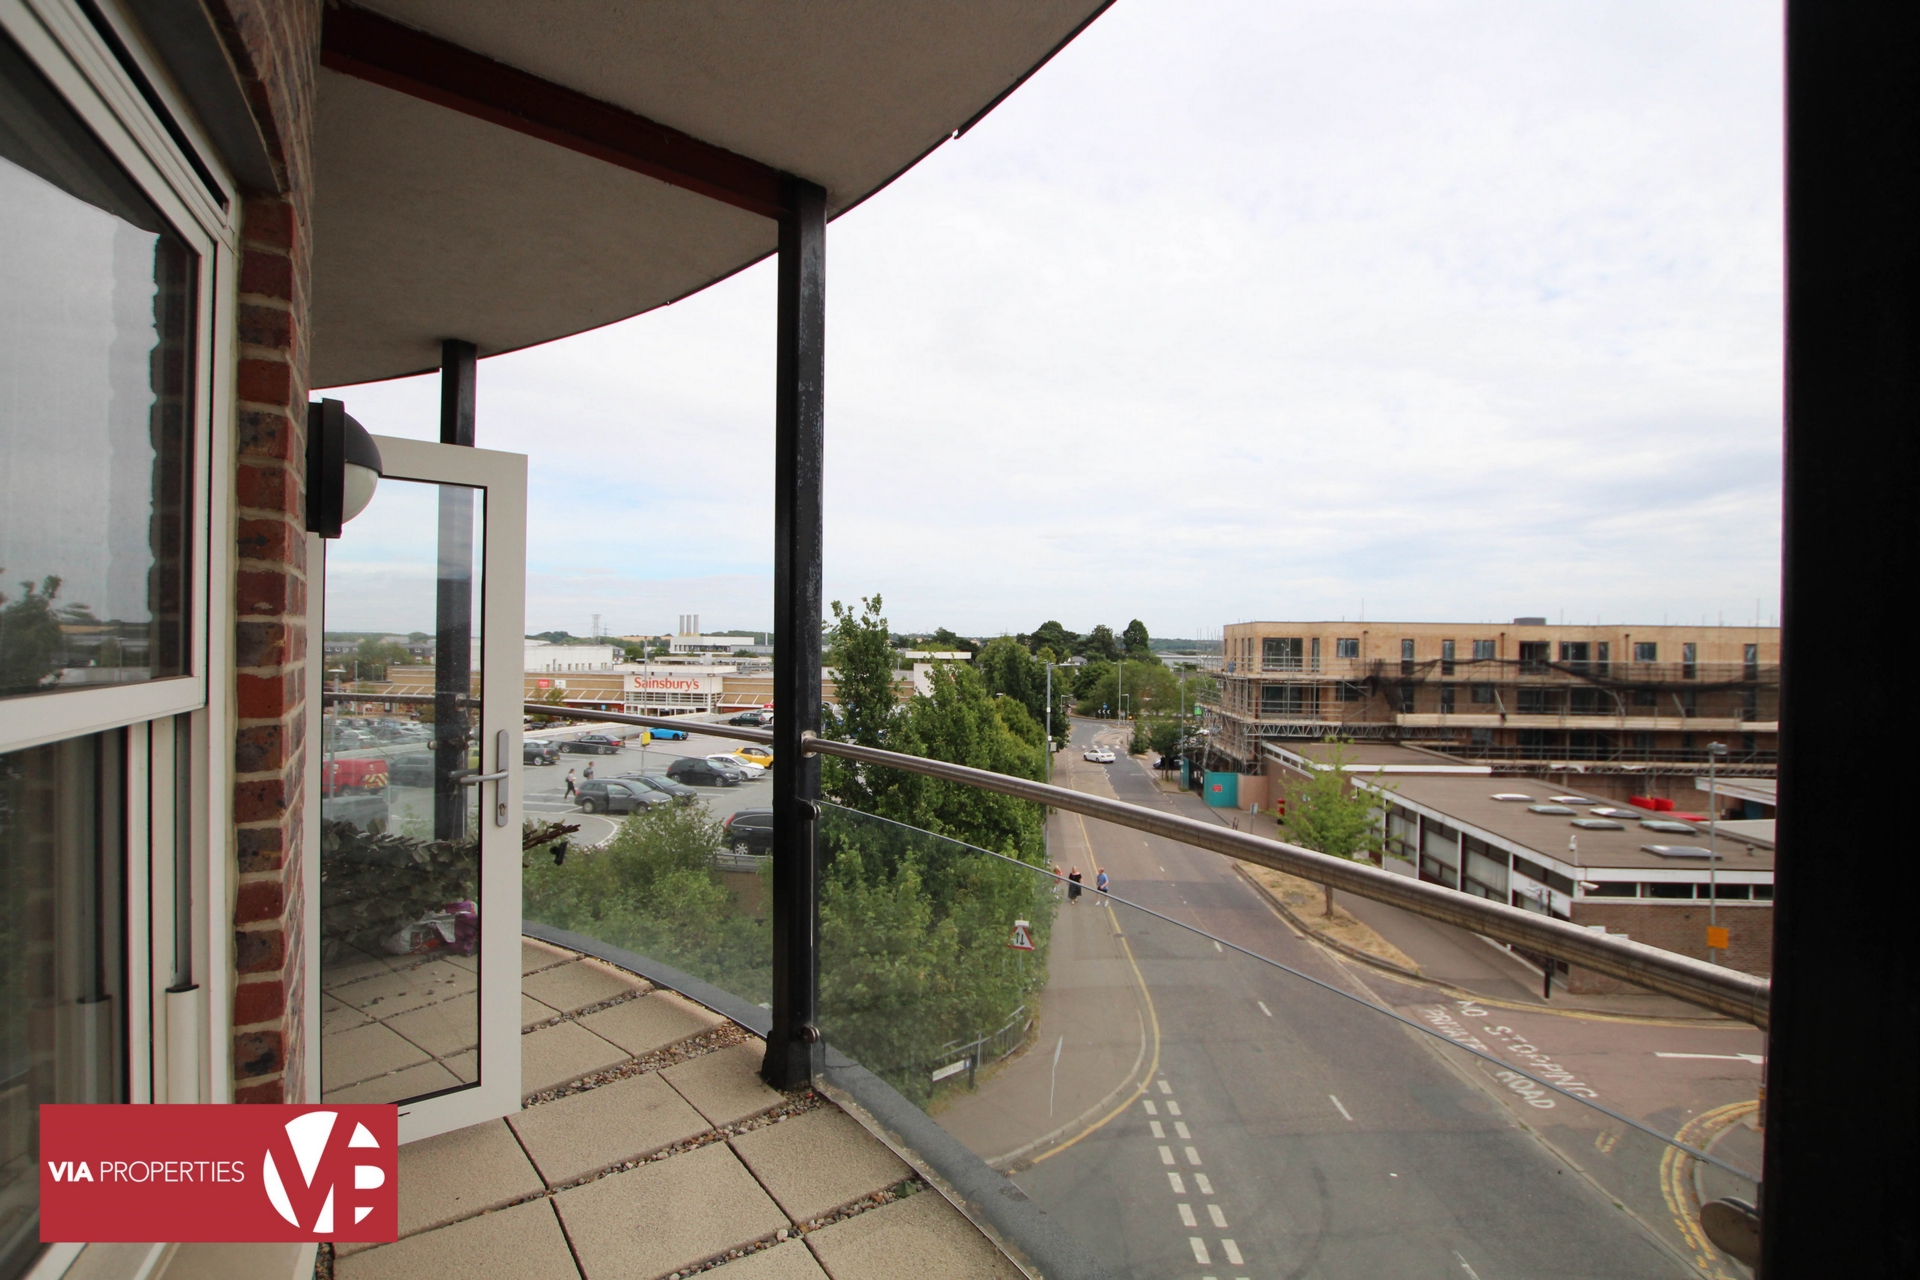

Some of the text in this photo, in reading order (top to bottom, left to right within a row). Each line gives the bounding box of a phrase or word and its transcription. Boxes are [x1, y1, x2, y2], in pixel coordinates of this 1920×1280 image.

[634, 677, 699, 692] Sainsbury's
[1457, 1000, 1598, 1098] NO STOPPING
[1496, 1071, 1556, 1109] ROAD
